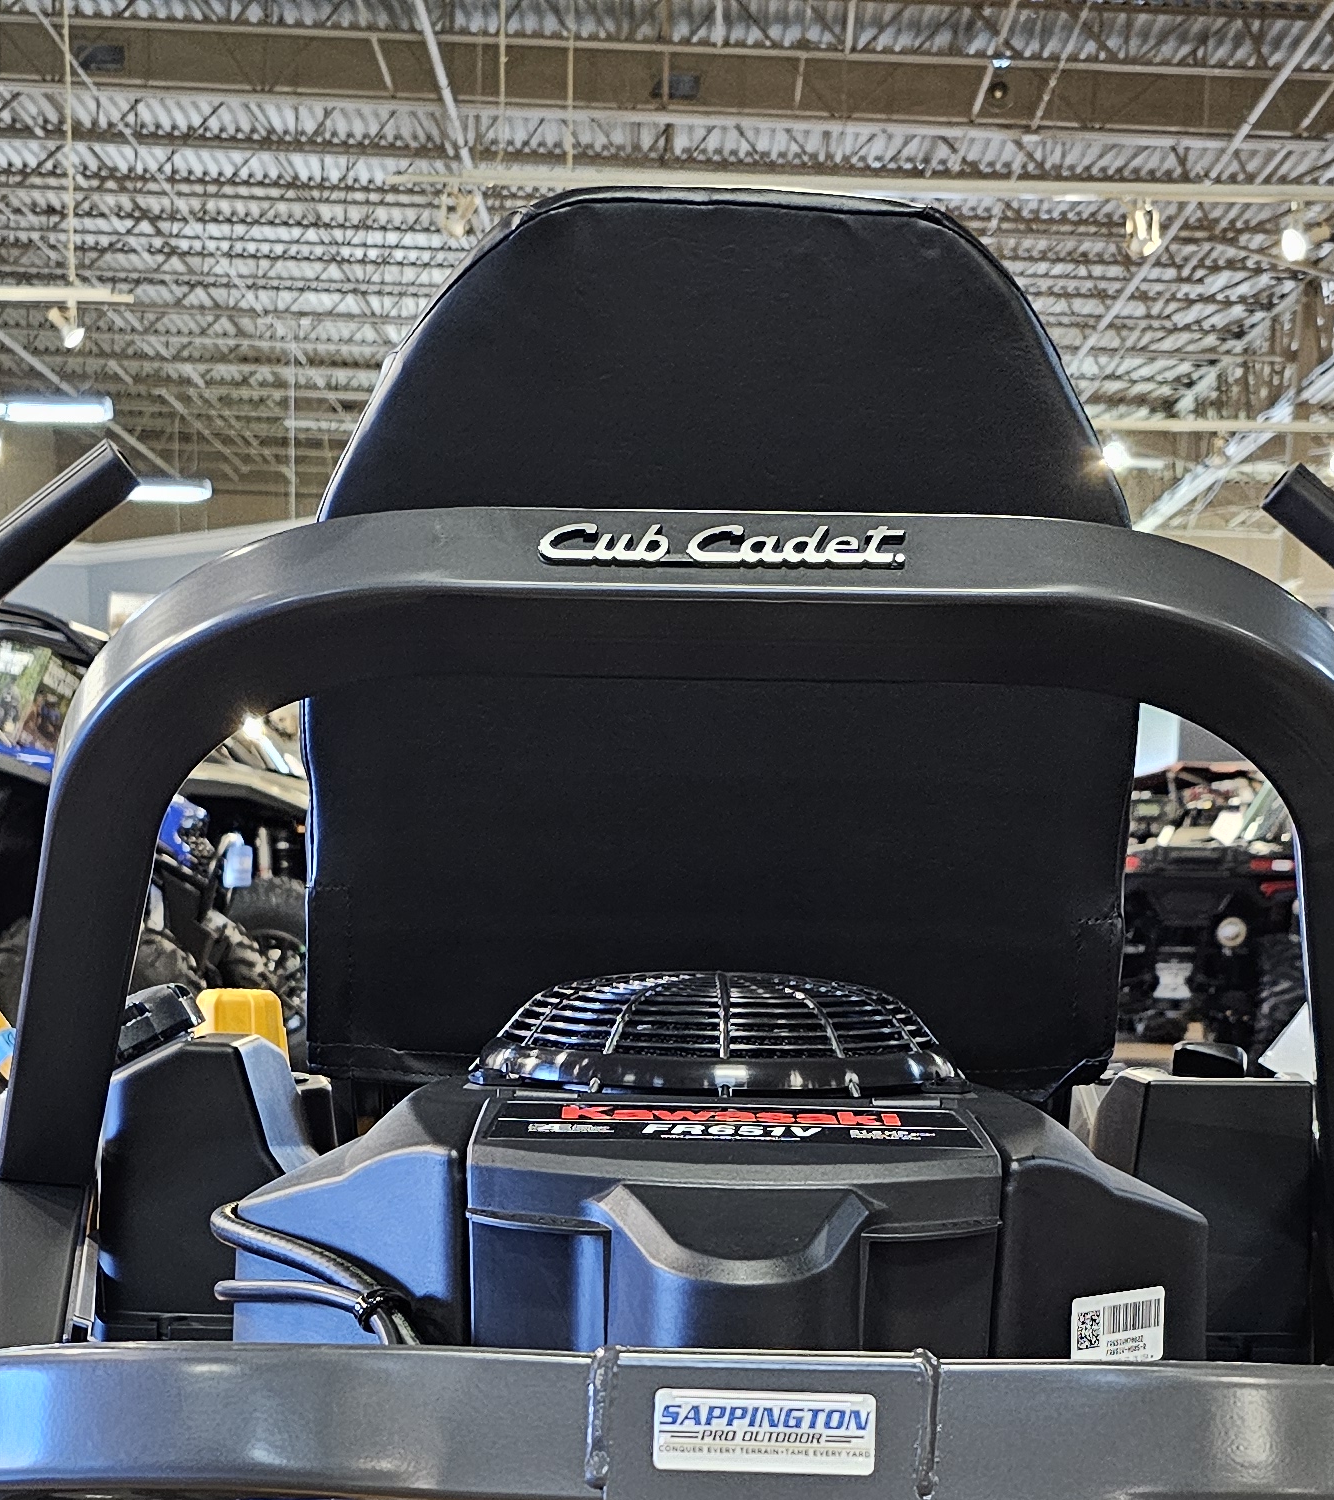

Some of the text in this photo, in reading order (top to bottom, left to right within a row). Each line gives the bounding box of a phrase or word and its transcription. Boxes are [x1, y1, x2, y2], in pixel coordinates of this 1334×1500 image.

[539, 522, 905, 566] Cub Cadet
[561, 1105, 901, 1127] Kawasaki
[641, 1123, 823, 1137] FR651V
[660, 1404, 872, 1431] SAPPINGTON
[701, 1430, 823, 1444] PRO OUTDOOR
[658, 1444, 704, 1453] CONQUER
[707, 1446, 736, 1454] EVERY
[813, 1449, 843, 1458] EVERY
[846, 1450, 871, 1459] YARD
